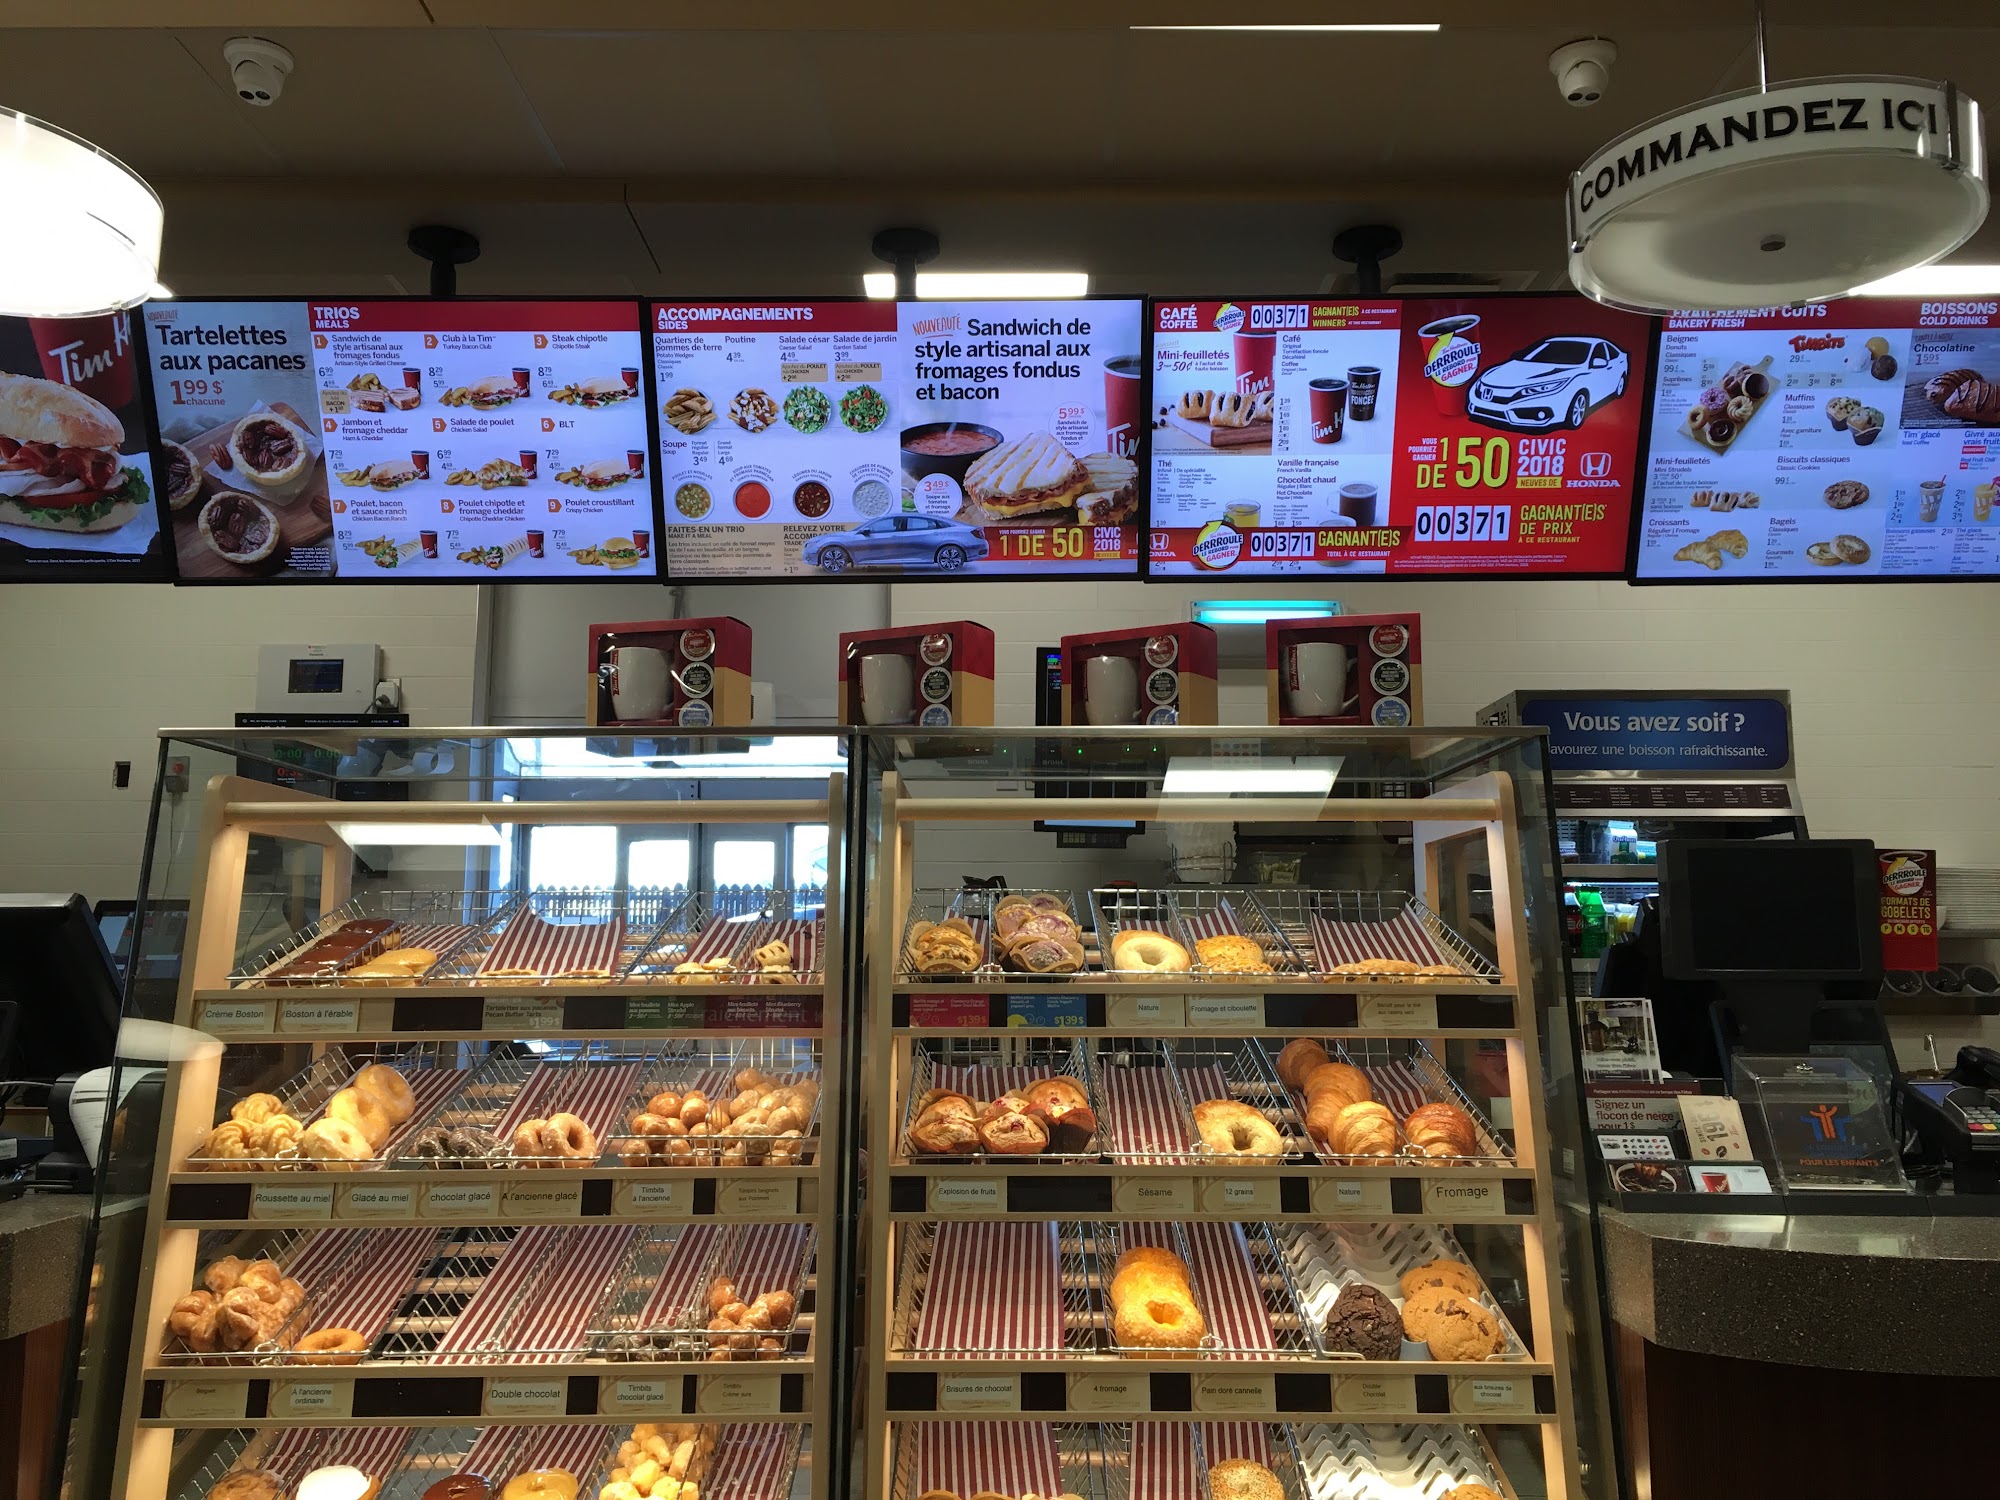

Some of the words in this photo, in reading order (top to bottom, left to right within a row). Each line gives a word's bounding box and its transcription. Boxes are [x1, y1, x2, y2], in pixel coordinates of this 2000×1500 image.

[1580, 99, 1869, 213] COMMANDEZ
[1883, 99, 1937, 134] ICI
[314, 306, 360, 320] TRIOS
[1160, 305, 1198, 320] CAFÉ
[1312, 306, 1359, 317] GAGNANT(E)S
[1782, 305, 1827, 317] CUITS
[1921, 302, 1997, 315] BOISSONS
[658, 307, 813, 321] ACCOMPAGNEMENTS
[1252, 308, 1307, 325] 00371
[315, 320, 349, 329] MEALS
[658, 321, 688, 329] SIDES
[912, 314, 961, 336] NOUVEAUTÉ
[1160, 320, 1198, 329] COFFEE
[1312, 319, 1346, 327] WINNERS
[1668, 319, 1709, 328] BAKERY
[1712, 318, 1745, 328] FRESH
[1920, 315, 1946, 325] COLD
[1949, 315, 1988, 325] DRINKS
[967, 319, 1063, 336] Sandwich
[1067, 318, 1091, 335] de
[155, 325, 287, 345] Tartelettes
[332, 334, 370, 343] Sandwich
[371, 334, 382, 342] de
[552, 334, 575, 343] Steak
[578, 334, 608, 344] chipotle
[655, 336, 692, 344] Quartiers
[693, 336, 704, 344] de
[833, 335, 859, 343] Salade
[861, 335, 871, 343] de
[873, 335, 897, 344] jardin
[1282, 334, 1301, 342] Café
[1666, 335, 1699, 343] Beignes
[333, 343, 352, 351] style
[656, 344, 689, 352] pommes
[915, 341, 961, 361] style
[967, 340, 1050, 357] artisanal
[1056, 343, 1090, 357] aux
[1914, 343, 1975, 352] Chocolatine
[334, 351, 371, 360] fromages
[372, 351, 400, 359] fondus
[1157, 350, 1230, 360] Mini-feuilletés
[49, 340, 112, 386] Tim
[160, 355, 203, 370] aux
[209, 353, 305, 375] pacanes
[916, 363, 1008, 382] fromages
[1013, 361, 1080, 378] fondus
[916, 385, 935, 400] et
[940, 384, 999, 400] bacon
[1785, 393, 1815, 401] Muffins
[186, 397, 225, 406] chacune
[450, 418, 476, 426] Salade
[490, 418, 514, 427] poulet
[559, 420, 574, 428] BLT
[342, 427, 374, 435] fromage
[663, 440, 687, 450] Soupe
[1519, 439, 1566, 455] CIVIC
[1305, 459, 1339, 468] française
[1455, 437, 1510, 488] 50
[1655, 457, 1710, 466] Mini-feuilletés
[1777, 455, 1808, 464] Biscuits
[1811, 455, 1850, 464] classiques
[1517, 456, 1564, 476] 2018
[1277, 476, 1310, 484] Chocolat
[1417, 465, 1447, 488] DE
[1566, 479, 1620, 487] HONDA
[351, 500, 377, 509] Poulet,
[591, 498, 635, 506] croustillant
[1418, 511, 1505, 535] 00371
[1649, 518, 1690, 526] Croissants
[1770, 518, 1796, 526] Bagels
[1093, 527, 1121, 538] CIVIC
[1520, 522, 1535, 534] DE
[1543, 522, 1573, 534] PRIX
[1000, 536, 1008, 556] 1
[1019, 535, 1044, 556] DE
[1052, 527, 1084, 558] 50
[1318, 530, 1401, 547] GAGNANT(E)S
[1093, 539, 1120, 551] 2018
[1564, 712, 1621, 732] Vous
[1627, 714, 1681, 732] avez
[1687, 712, 1728, 732] soif
[1733, 713, 1744, 732] ?
[1550, 745, 1598, 755] avourez
[1602, 746, 1624, 755] une
[1629, 744, 1675, 755] boisson
[1680, 744, 1768, 757] rafraîchissante.
[1920, 897, 1930, 906] DE
[1881, 907, 1931, 918] GOBELETS
[205, 1009, 233, 1019] Crème
[236, 1010, 264, 1018] Boston
[1594, 1099, 1629, 1111] Signez
[1632, 1102, 1645, 1110] un
[1596, 1110, 1627, 1120] flocon
[1630, 1111, 1643, 1119] de
[1646, 1112, 1674, 1122] neige
[1597, 1122, 1620, 1130] pour
[1841, 1159, 1879, 1167] ENFANTS
[430, 1192, 465, 1201] chocolat
[468, 1191, 490, 1202] glacé
[1138, 1187, 1172, 1196] Sésame
[1339, 1188, 1360, 1196] Nature
[1436, 1186, 1488, 1199] Fromage
[256, 1193, 298, 1202] Roussette
[313, 1194, 331, 1202] miel
[985, 1384, 1012, 1392] chocolat
[1202, 1386, 1216, 1394] Pain
[1218, 1386, 1233, 1394] doré
[1235, 1386, 1262, 1394] cannelle
[492, 1389, 522, 1398] Double
[525, 1389, 561, 1398] chocolat
